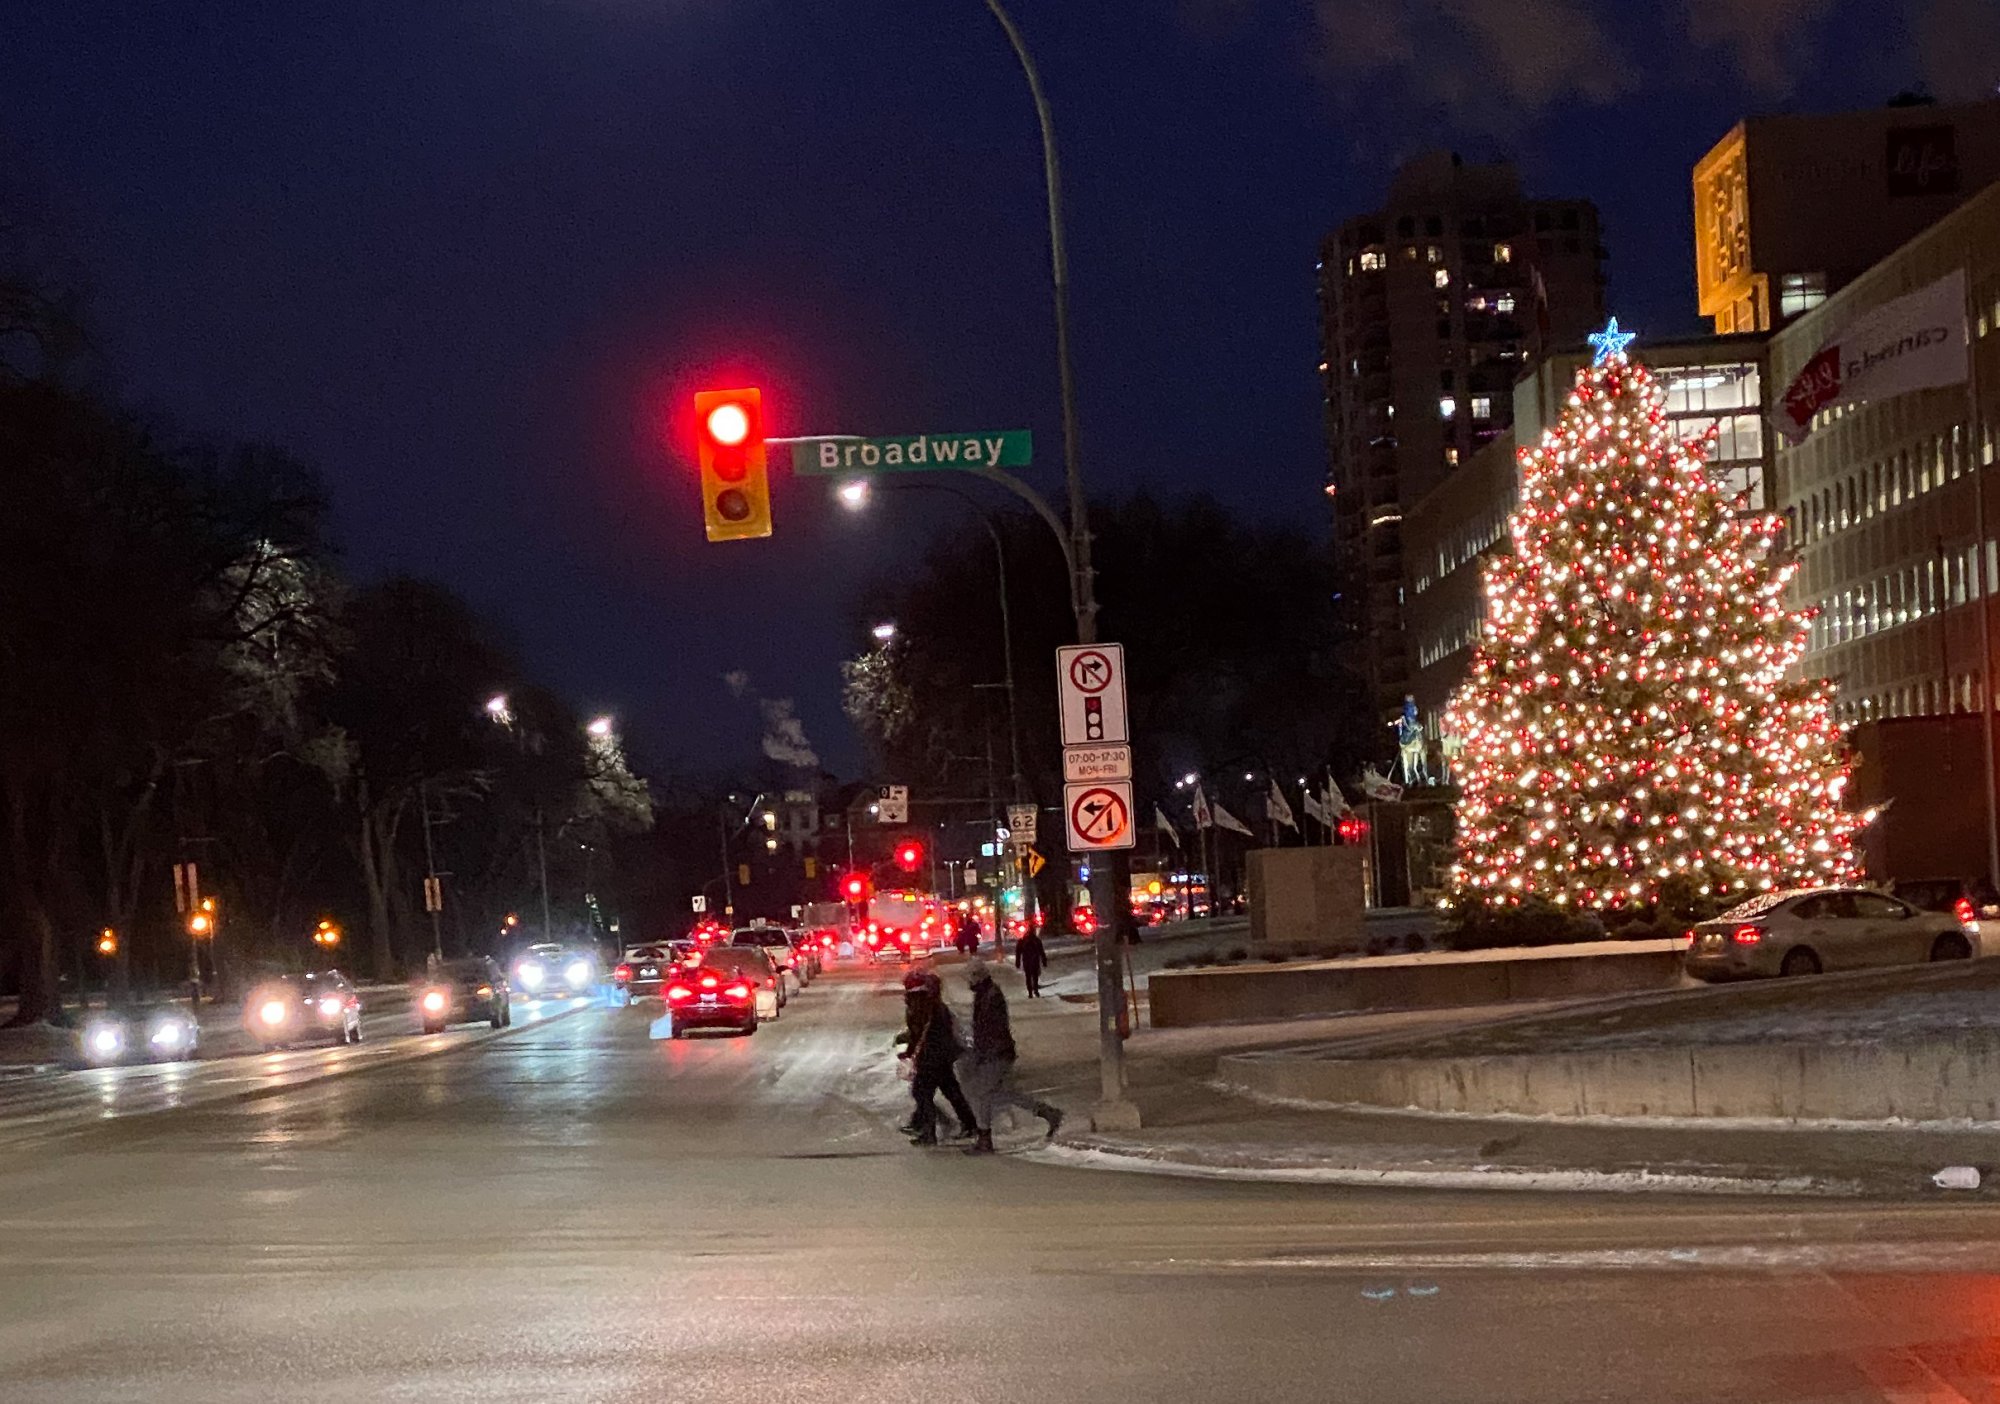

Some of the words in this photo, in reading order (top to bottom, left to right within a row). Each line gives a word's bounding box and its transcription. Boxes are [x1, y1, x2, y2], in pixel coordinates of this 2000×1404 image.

[819, 435, 1004, 468] Broadway
[1068, 751, 1126, 764] 07:00-17:30
[1078, 764, 1118, 775] MON-FRI
[1012, 815, 1034, 828] 62
